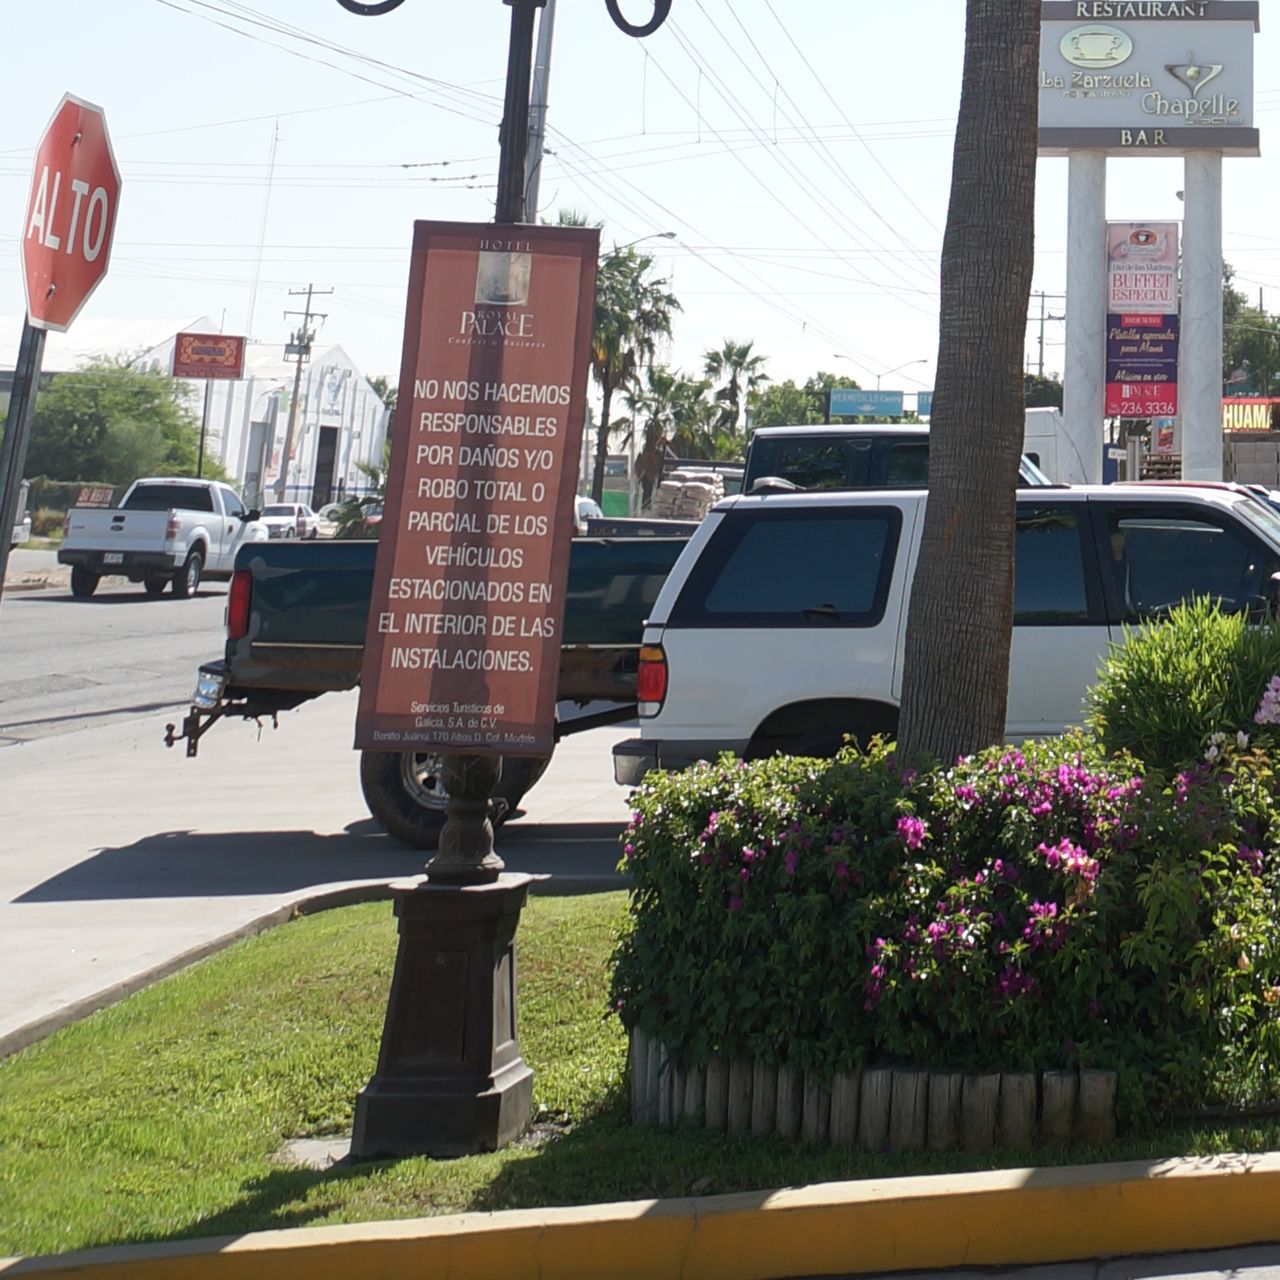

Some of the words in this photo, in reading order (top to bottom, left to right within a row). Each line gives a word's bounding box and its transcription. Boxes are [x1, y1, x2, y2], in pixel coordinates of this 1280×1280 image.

[1075, 1, 1209, 18] RESTAURANT
[1040, 70, 1065, 89] La
[1071, 70, 1152, 89] Zarzuela
[1141, 92, 1240, 119] Chapelle
[1120, 129, 1168, 146] BAR
[27, 165, 109, 262] ALTO
[480, 239, 534, 252] HOTEL
[1112, 273, 1173, 289] BUFFET
[1112, 289, 1172, 302] ESPECIAL
[460, 311, 535, 337] PALACE
[477, 310, 519, 321] ROYAL
[413, 379, 439, 399] NO
[443, 380, 480, 401] NOS
[484, 382, 571, 405] HACEMOS
[1121, 402, 1142, 414] 236
[1145, 402, 1174, 414] 3336
[419, 412, 557, 438] RESPONSABLES
[416, 445, 453, 465] POR
[458, 443, 520, 468] DAÑOS
[524, 449, 554, 471] Y/O
[418, 478, 469, 499] ROBO
[473, 480, 528, 502] TOTAL
[531, 482, 545, 503] O
[407, 511, 482, 533] PARCIAL
[486, 514, 511, 534] DE
[514, 515, 548, 536] LOS
[426, 542, 524, 568] VEHÍCULOS
[388, 578, 524, 603] ESTACIONADOS
[528, 583, 552, 603] EN
[378, 612, 400, 633] EL
[404, 613, 488, 635] INTERIOR
[491, 616, 516, 637] DE
[520, 617, 555, 638] LAS
[390, 647, 534, 672] INSTALACIONES.
[410, 701, 450, 714] Servicios
[493, 703, 505, 715] de
[373, 730, 400, 741] Benito
[468, 718, 479, 729] de
